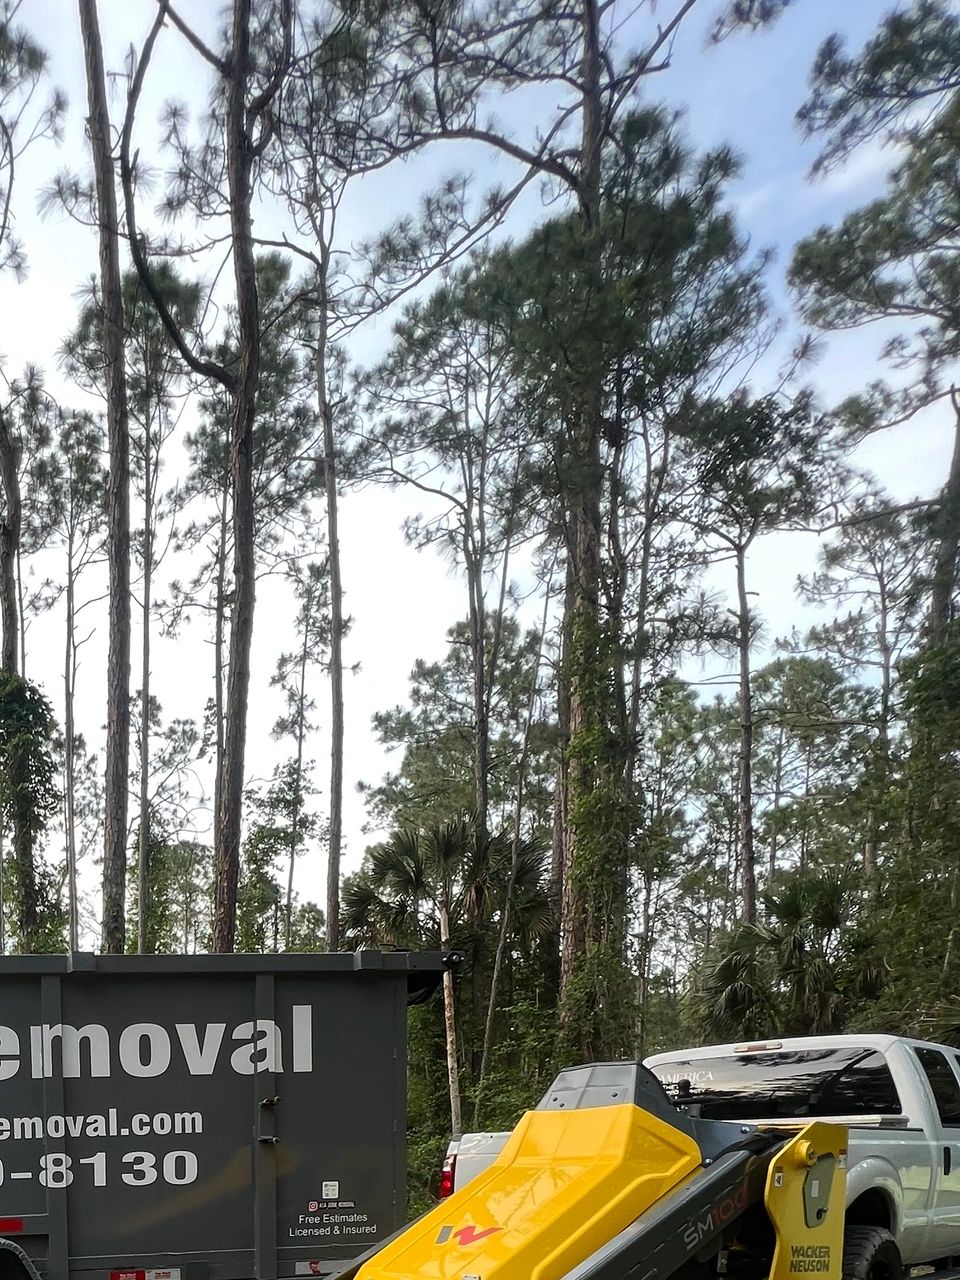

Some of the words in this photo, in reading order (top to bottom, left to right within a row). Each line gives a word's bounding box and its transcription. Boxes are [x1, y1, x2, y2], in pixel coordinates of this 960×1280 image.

[298, 1214, 320, 1225] Free
[323, 1213, 368, 1224] Estimates
[289, 1227, 331, 1237] Licensed
[333, 1225, 340, 1235] &
[343, 1224, 377, 1234] Insured
[790, 1245, 830, 1259] WACKER
[789, 1259, 830, 1273] NEUSON
